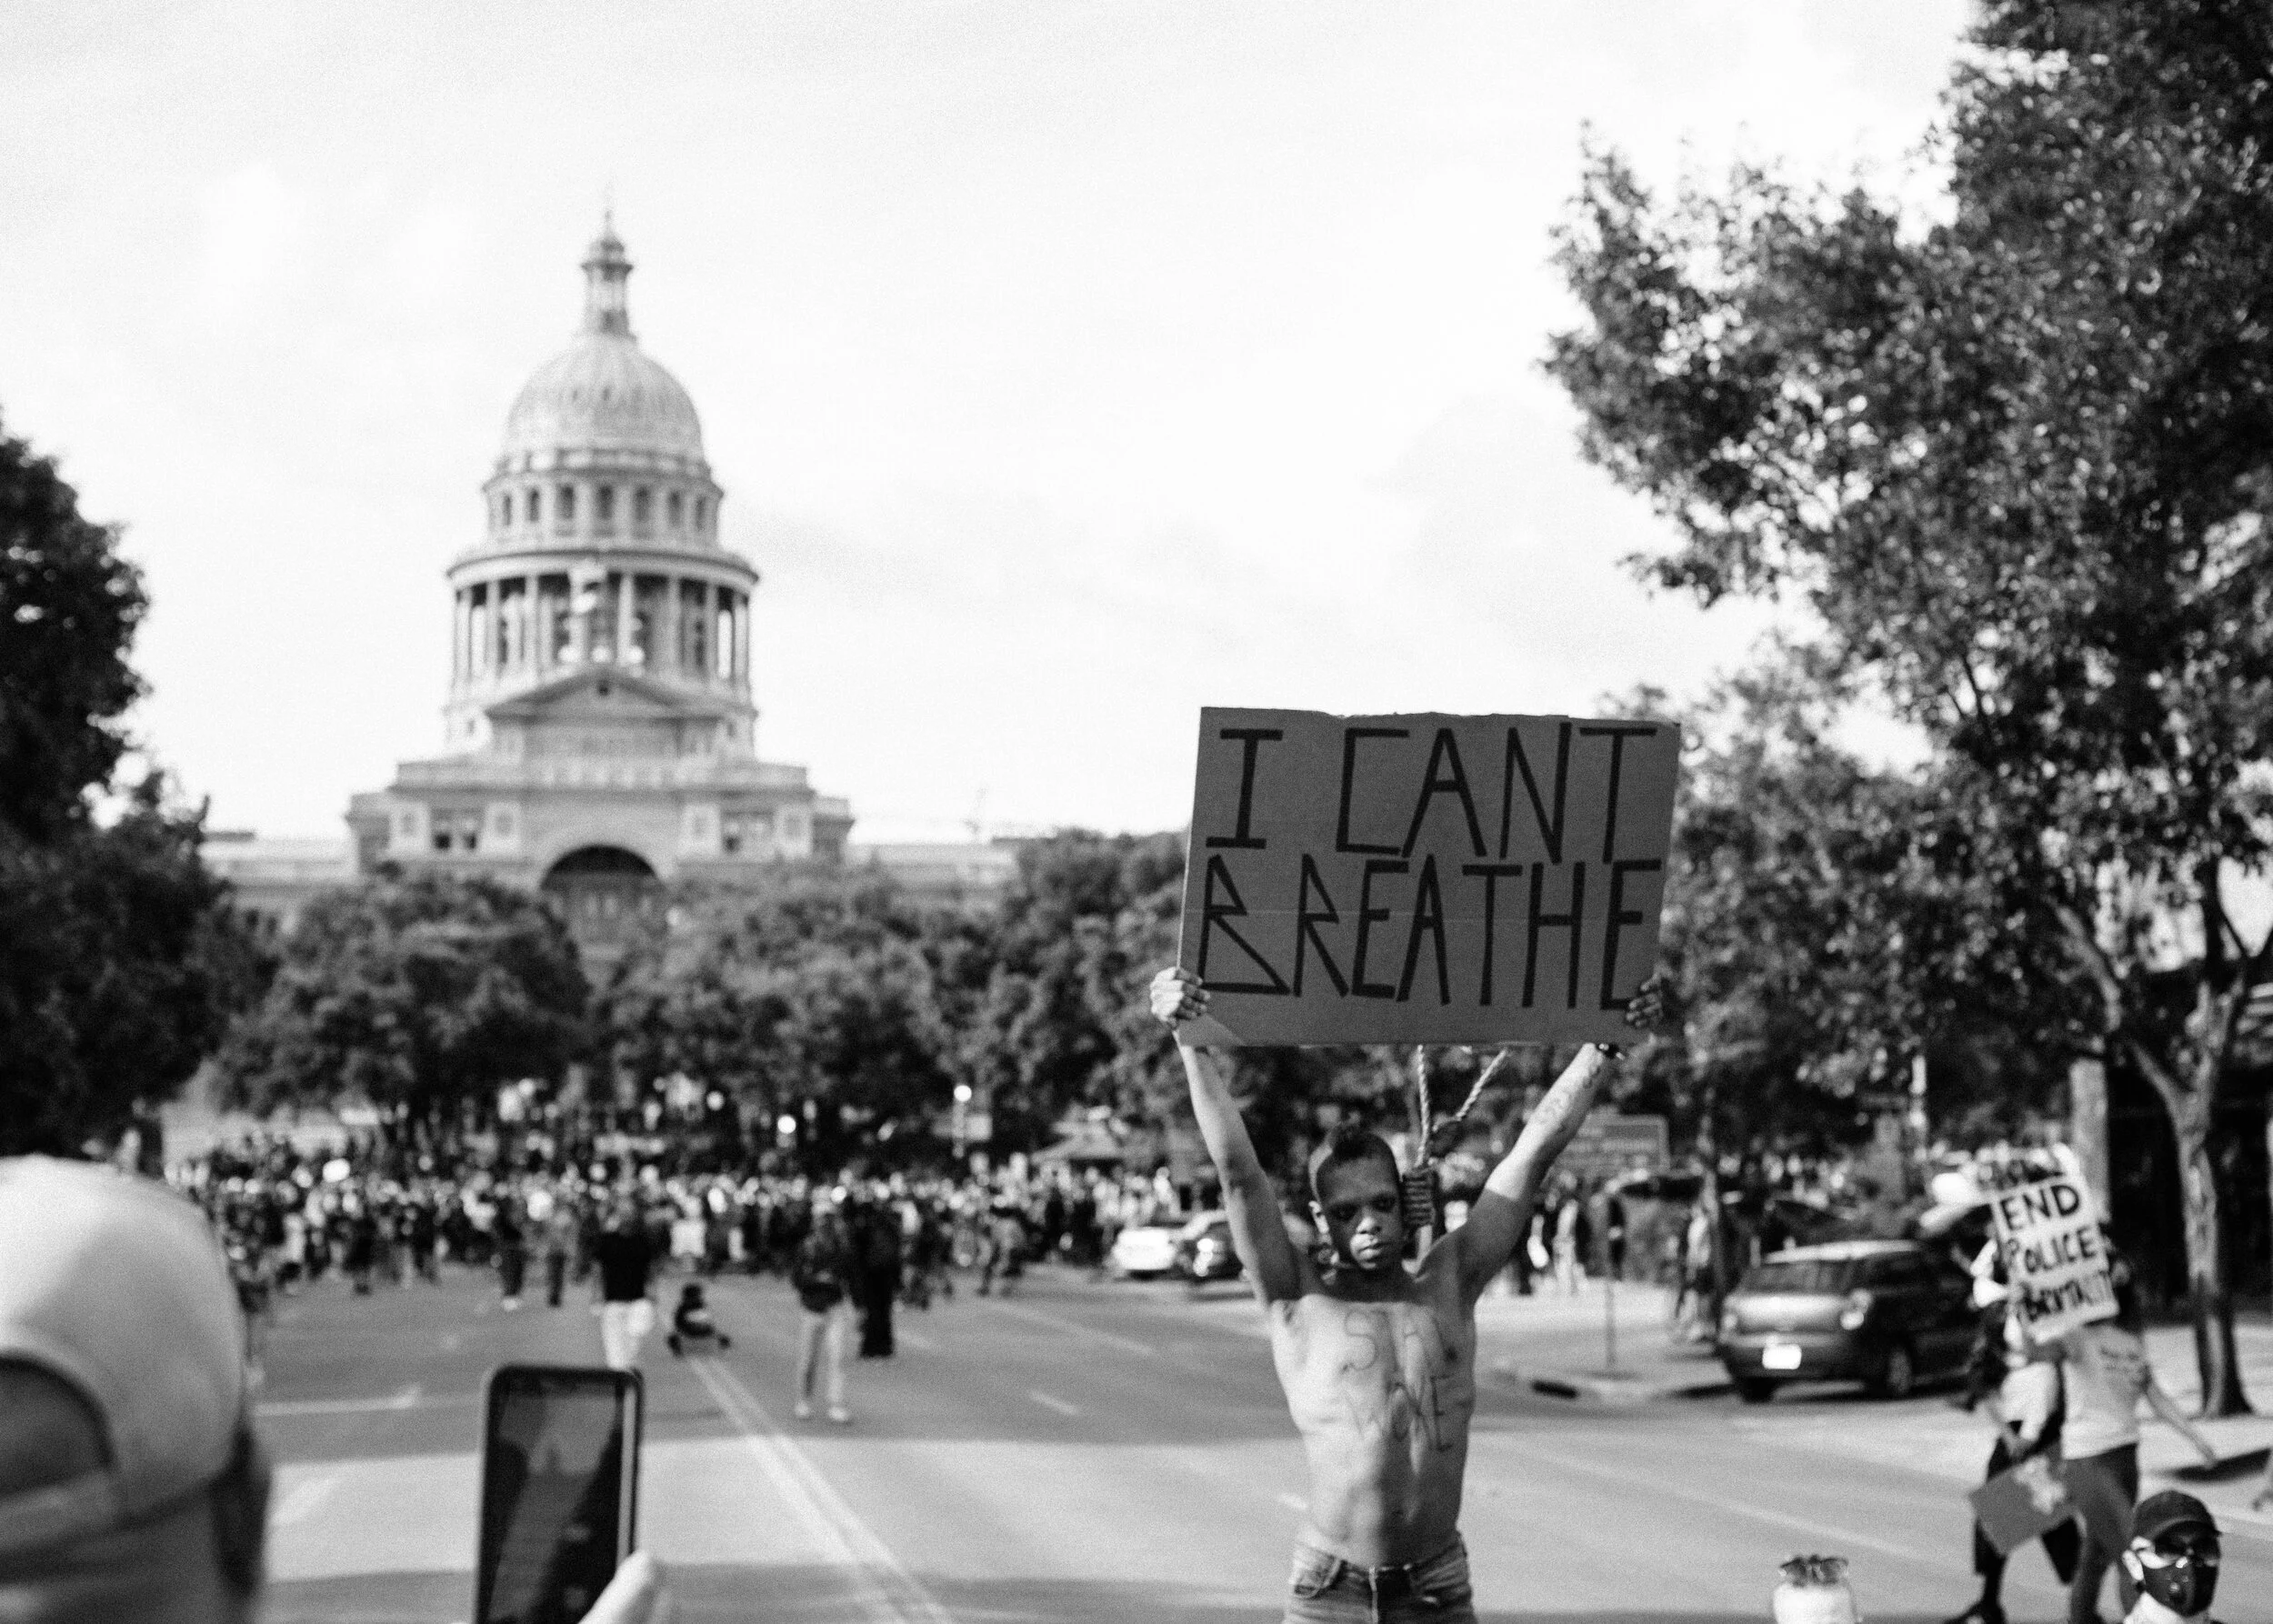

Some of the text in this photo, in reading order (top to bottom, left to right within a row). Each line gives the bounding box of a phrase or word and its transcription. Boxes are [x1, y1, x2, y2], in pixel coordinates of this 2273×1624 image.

[1206, 722, 1657, 865] I CANT
[1197, 853, 1662, 1010] BREATHE
[2000, 1184, 2080, 1231] END
[2004, 1228, 2096, 1274] POLICE
